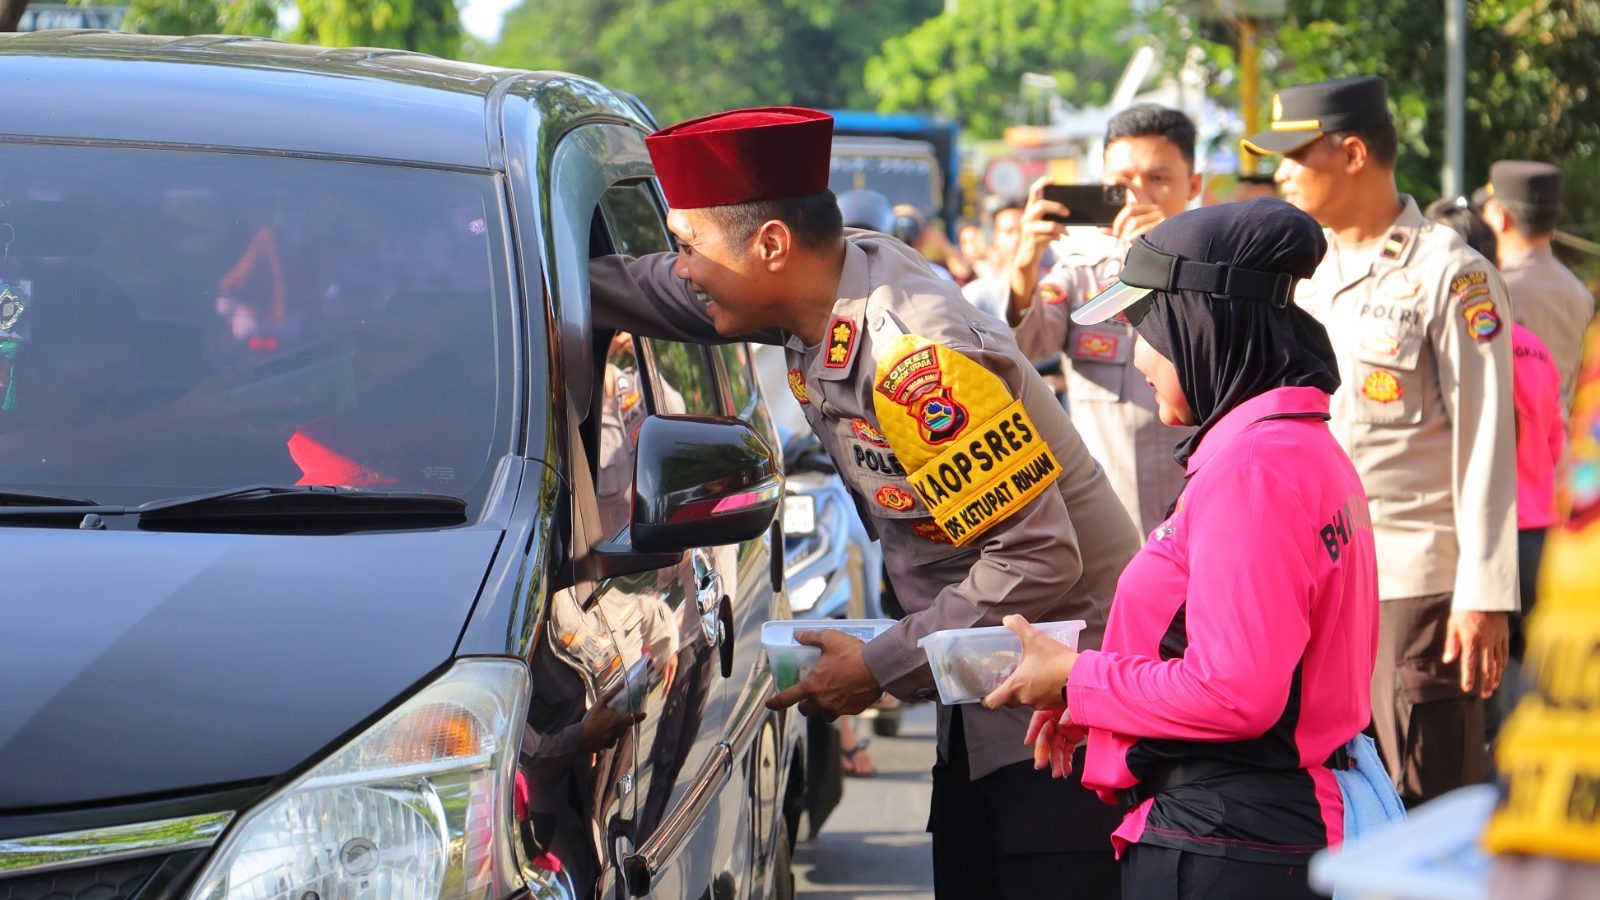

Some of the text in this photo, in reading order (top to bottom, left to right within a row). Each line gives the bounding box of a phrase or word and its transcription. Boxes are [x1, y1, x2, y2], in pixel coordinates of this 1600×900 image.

[1360, 304, 1419, 325] POLRI
[883, 351, 930, 390] POLRES
[914, 412, 1032, 509] KAOPSRES
[959, 481, 1014, 530] KETUPAT
